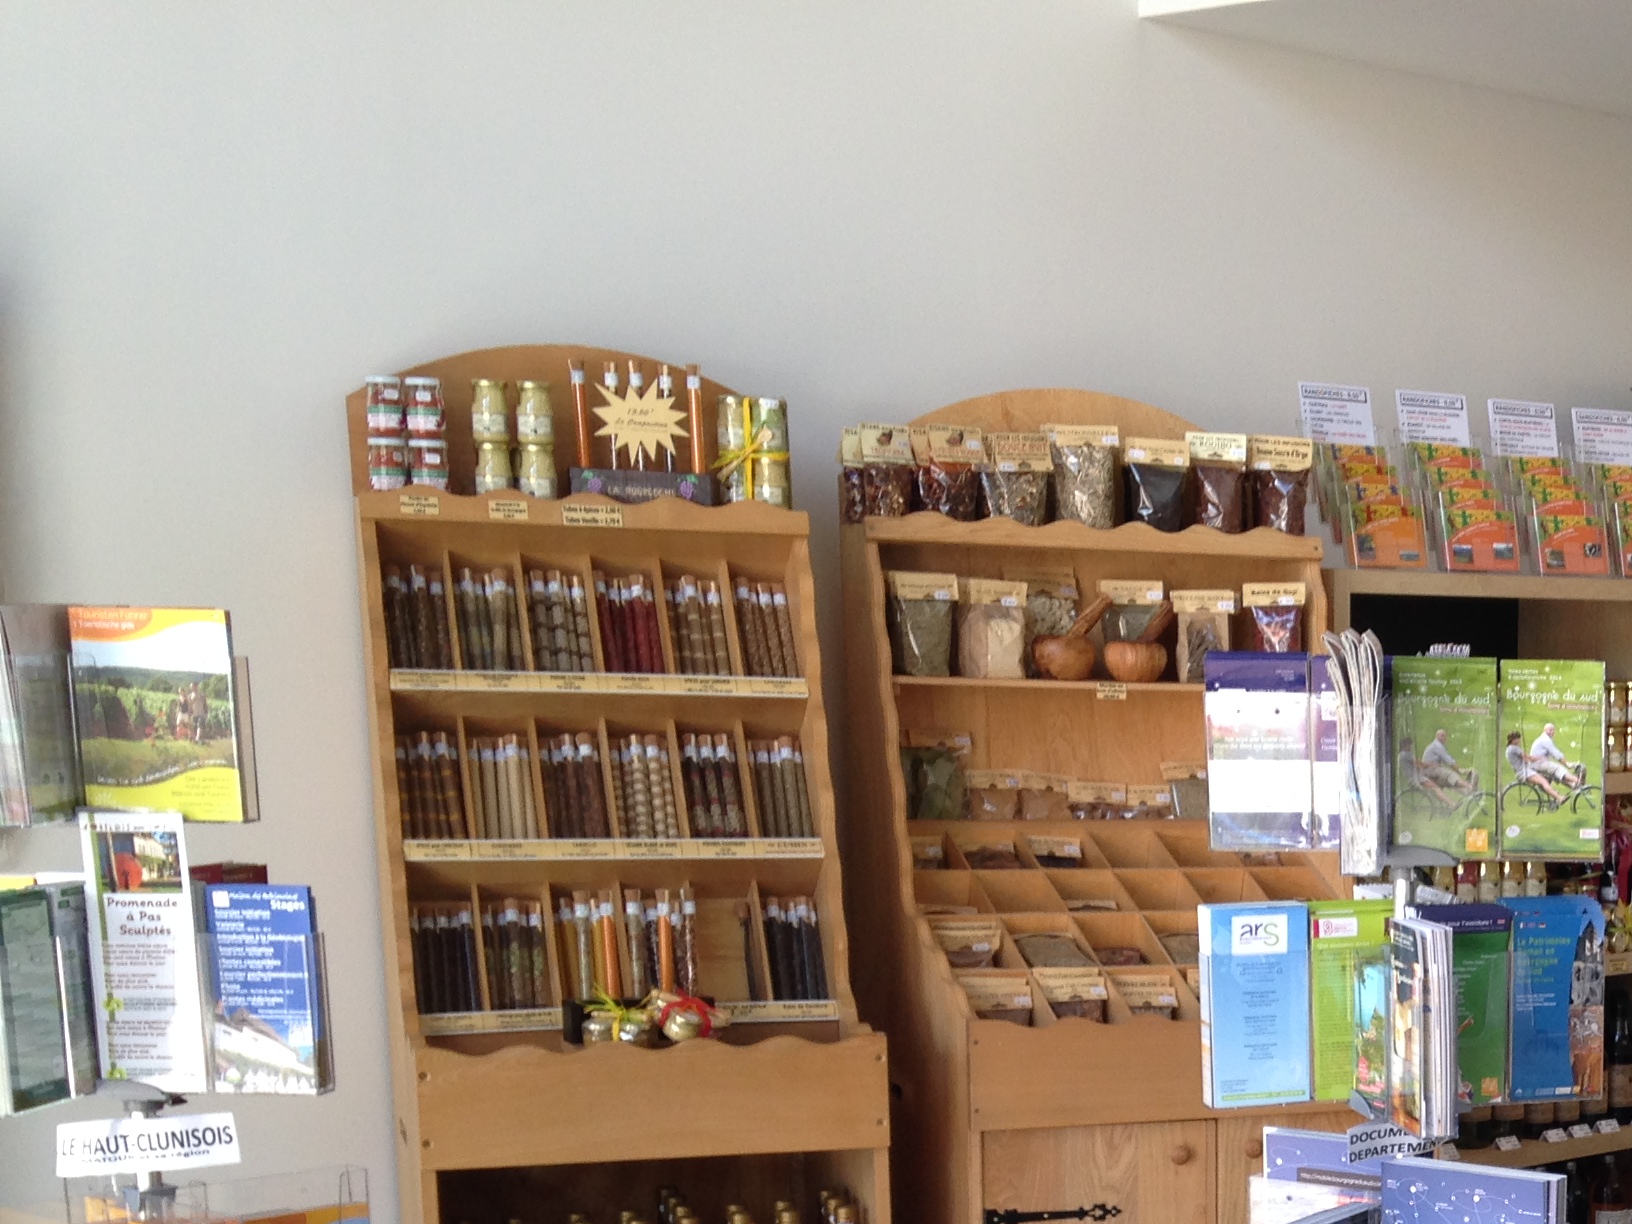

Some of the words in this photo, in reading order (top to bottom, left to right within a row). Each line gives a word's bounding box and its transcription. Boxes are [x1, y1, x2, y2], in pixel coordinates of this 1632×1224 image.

[1454, 692, 1468, 704] du
[1471, 692, 1491, 705] sud
[1506, 688, 1559, 704] Bourgogne
[1562, 688, 1577, 702] du
[1578, 689, 1599, 703] sud
[107, 897, 178, 908] Promenade
[270, 899, 305, 912] Stages
[127, 911, 135, 921] à
[140, 911, 162, 921] Pas
[119, 924, 171, 937] Sculptés
[62, 1138, 76, 1157] LE
[82, 1125, 234, 1156] HAUT-CLUNISOIS
